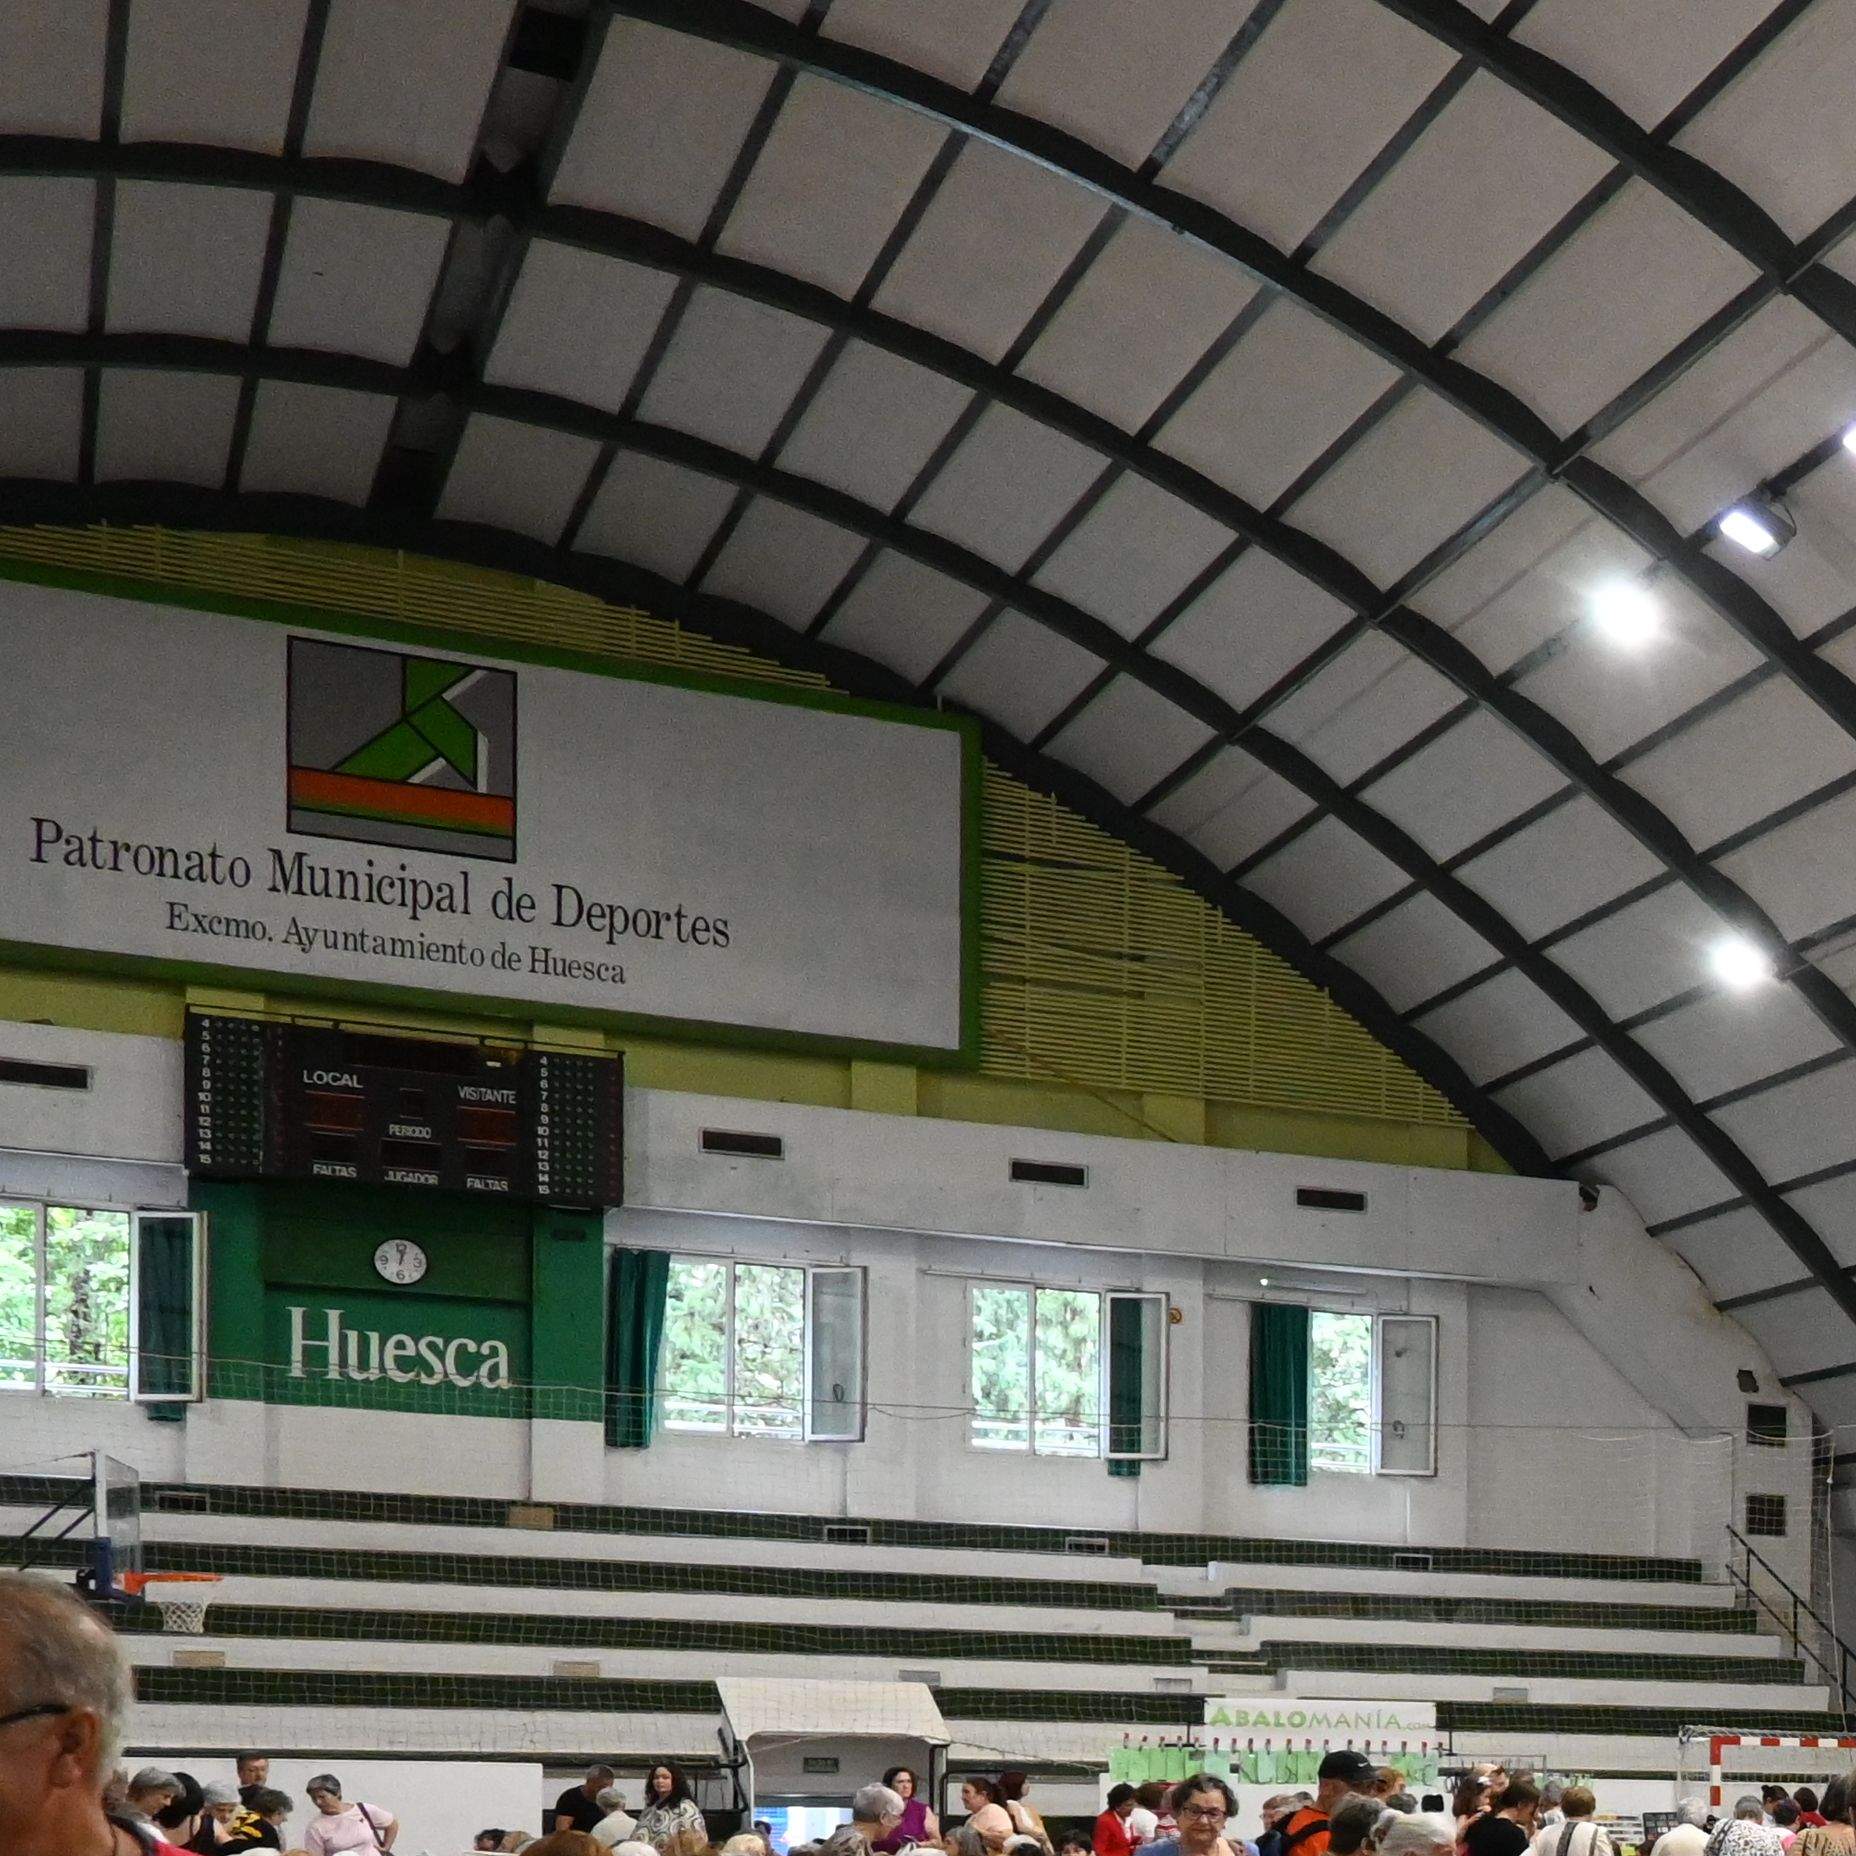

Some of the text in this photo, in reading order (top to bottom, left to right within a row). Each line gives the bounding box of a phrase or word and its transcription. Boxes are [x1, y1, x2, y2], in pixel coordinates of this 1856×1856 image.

[30, 816, 730, 948] Patronato Municipal de Deportes
[165, 901, 626, 984] Excmo. Ayuntamiento de Huesca
[303, 1069, 363, 1089] LOCAL
[457, 1085, 517, 1105] VISITANTE
[388, 1123, 432, 1139] PERIODO
[313, 1163, 358, 1179] FALTAS
[384, 1170, 439, 1186] JUGADOR
[466, 1177, 509, 1192] FALTAS
[396, 1269, 406, 1280] 6
[285, 1306, 510, 1390] Huesca
